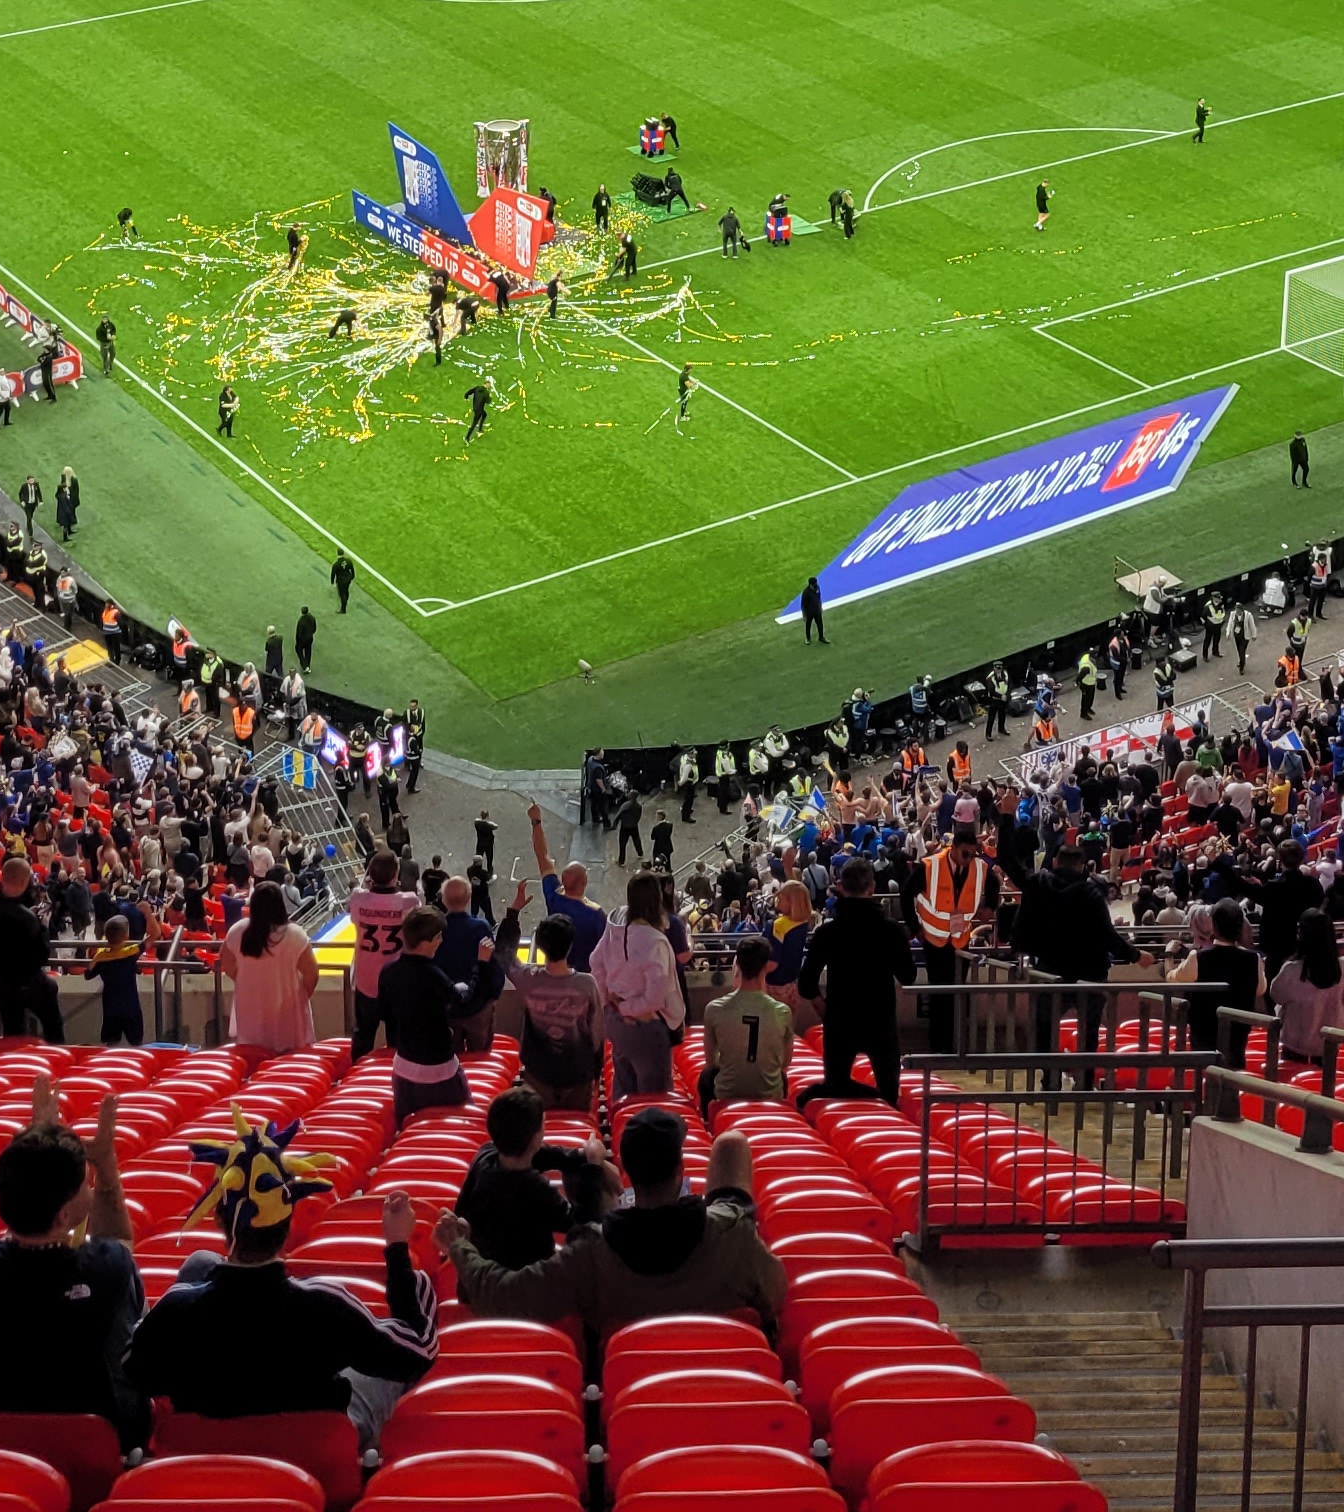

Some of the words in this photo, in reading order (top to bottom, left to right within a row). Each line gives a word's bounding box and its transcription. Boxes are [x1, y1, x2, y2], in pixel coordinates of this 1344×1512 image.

[387, 222, 402, 244] WE
[402, 232, 443, 268] STEPPED
[445, 256, 459, 277] UP
[1069, 440, 1123, 491] THE
[1116, 430, 1167, 476] bet
[1148, 413, 1202, 472] sky
[840, 510, 912, 567] APP
[359, 922, 404, 955] 33
